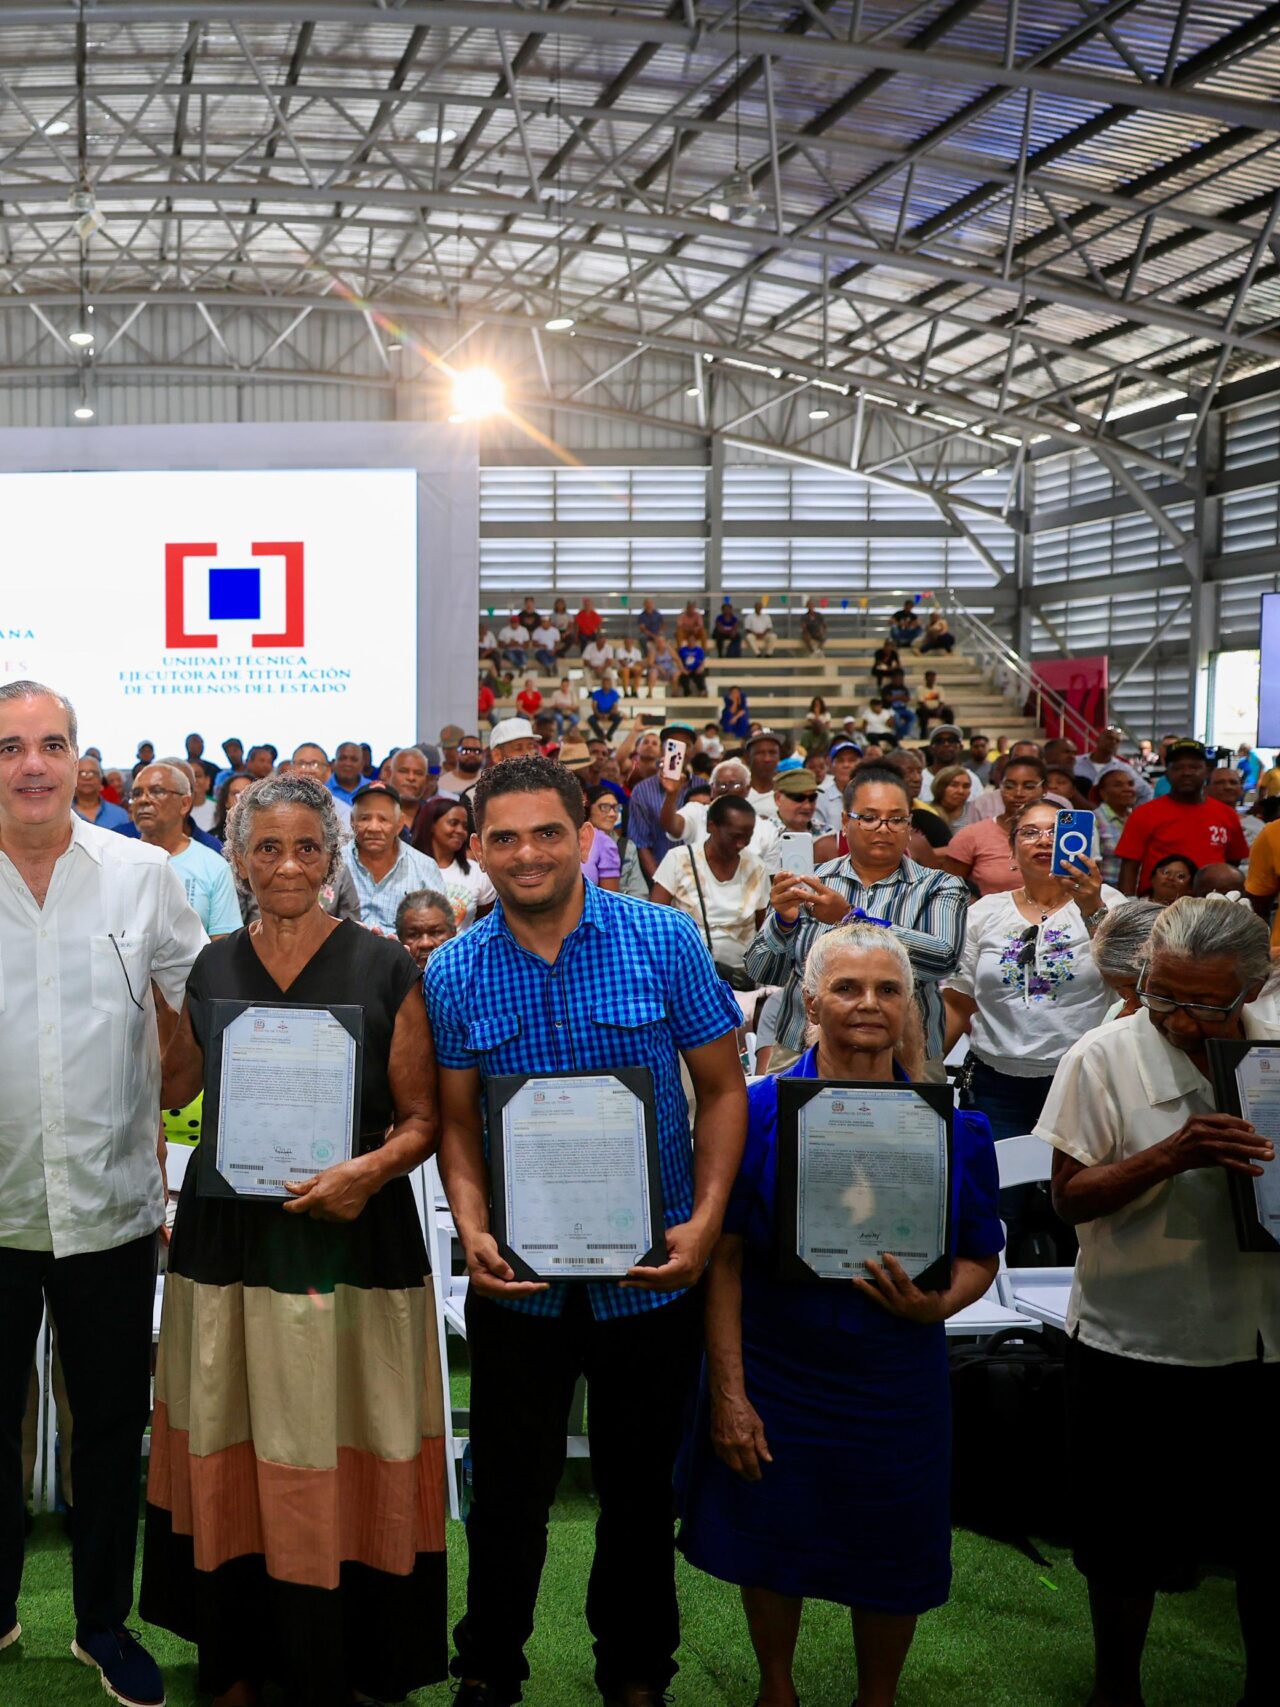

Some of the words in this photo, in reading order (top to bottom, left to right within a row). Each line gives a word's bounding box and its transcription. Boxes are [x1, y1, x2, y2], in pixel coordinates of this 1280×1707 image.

[162, 656, 230, 667] UNIDAD
[236, 655, 308, 666] TÉCNICA
[119, 670, 217, 682] EJECUTORA
[222, 669, 240, 680] DE
[248, 668, 352, 680] TITULACIÓN
[124, 684, 144, 695] DE
[151, 684, 241, 695] TERRENOS
[245, 683, 275, 694] DEL
[281, 683, 347, 694] ESTADO
